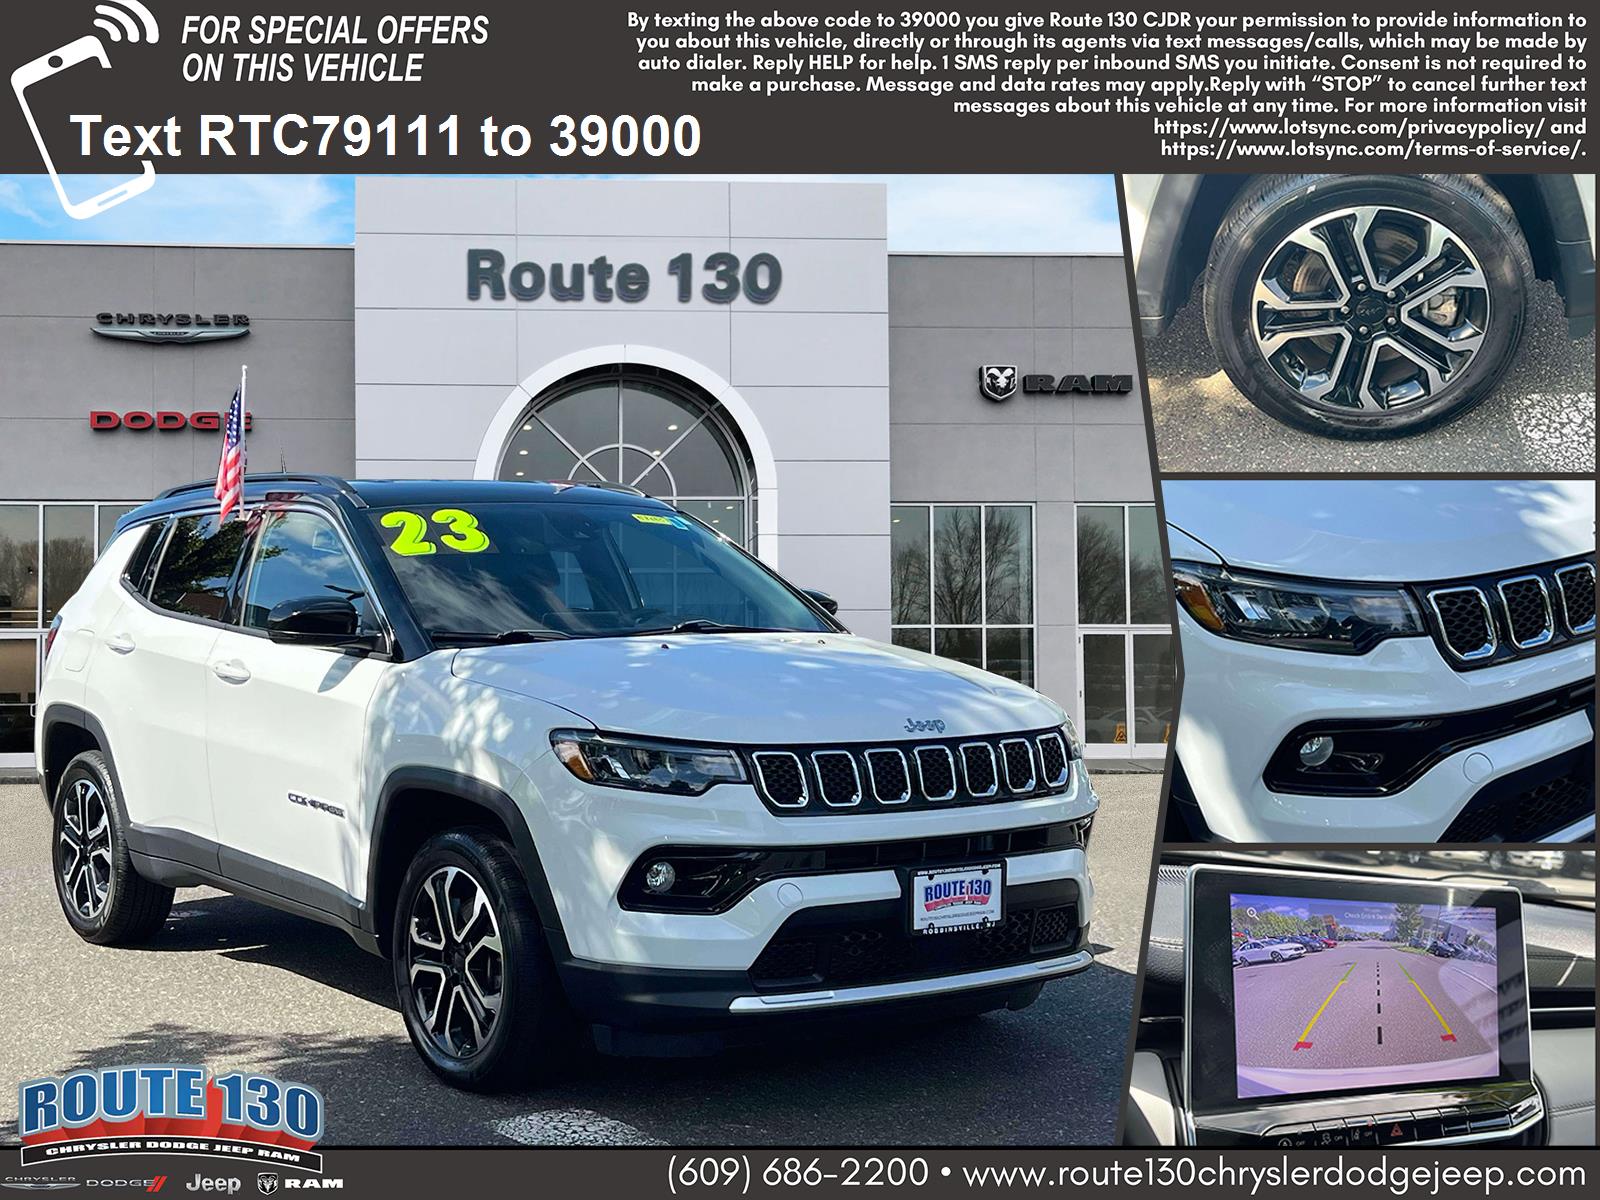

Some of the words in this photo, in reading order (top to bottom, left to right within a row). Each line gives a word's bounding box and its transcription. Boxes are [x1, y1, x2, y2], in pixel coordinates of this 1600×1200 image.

[467, 248, 650, 303] Route
[668, 252, 783, 304] 130
[96, 312, 250, 326] CHRYSLER
[1023, 374, 1133, 394] RAM
[380, 508, 492, 556] 23
[924, 880, 966, 902] ROUTE
[968, 880, 992, 896] 130
